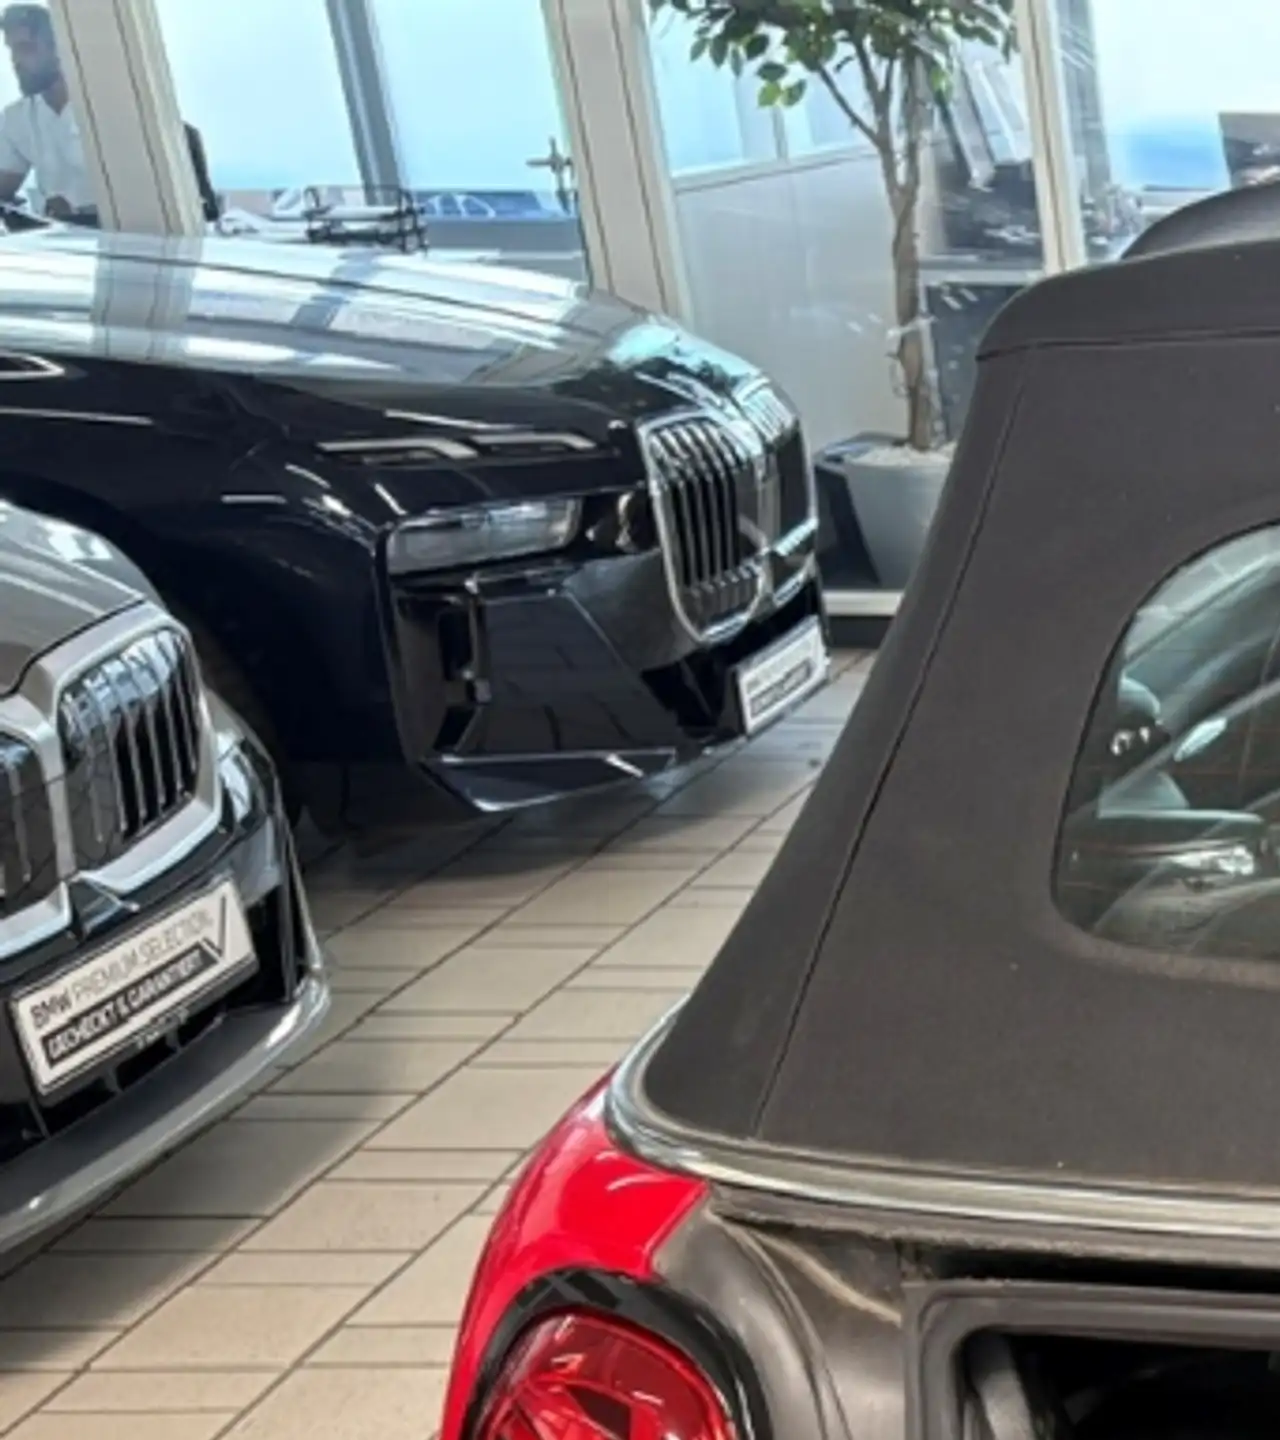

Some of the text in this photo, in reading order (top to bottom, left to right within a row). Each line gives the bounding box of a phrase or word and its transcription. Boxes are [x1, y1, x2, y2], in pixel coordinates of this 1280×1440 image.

[29, 990, 72, 1029] BMW
[71, 949, 138, 1001] PREMIUM
[139, 908, 213, 966] SELECTION
